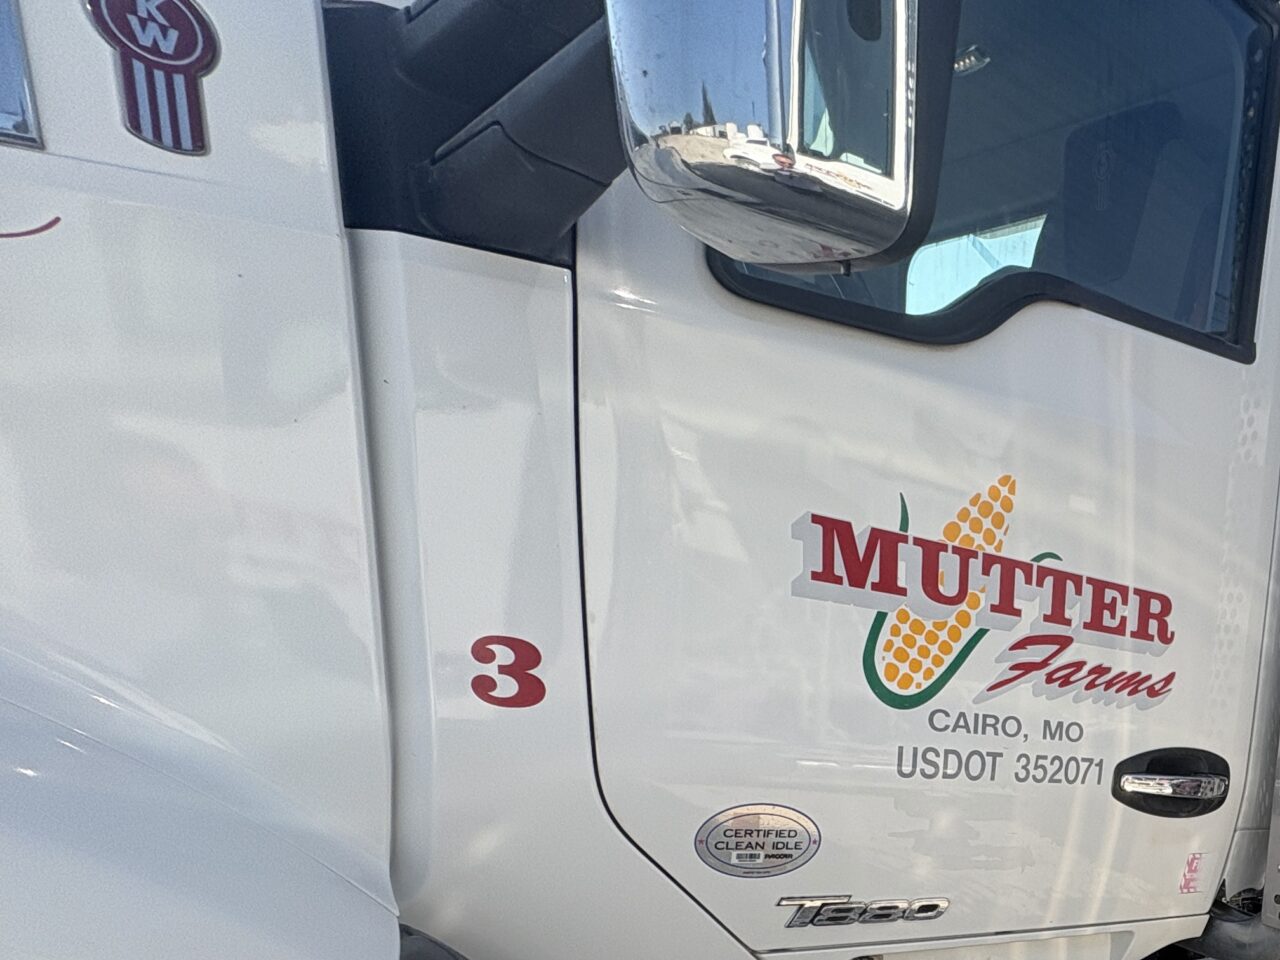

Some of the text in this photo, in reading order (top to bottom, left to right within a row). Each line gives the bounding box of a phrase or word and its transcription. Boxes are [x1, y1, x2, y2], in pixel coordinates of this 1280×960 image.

[811, 513, 1175, 645] MUTTER
[471, 635, 546, 708] 3
[987, 634, 1176, 698] Farms
[928, 708, 1084, 743] CAIRO, MO
[896, 745, 1104, 785] USDOT 352071
[714, 841, 804, 851] CLEAN IDLE
[723, 828, 798, 839] CERTIFIED
[776, 895, 950, 928] T880
